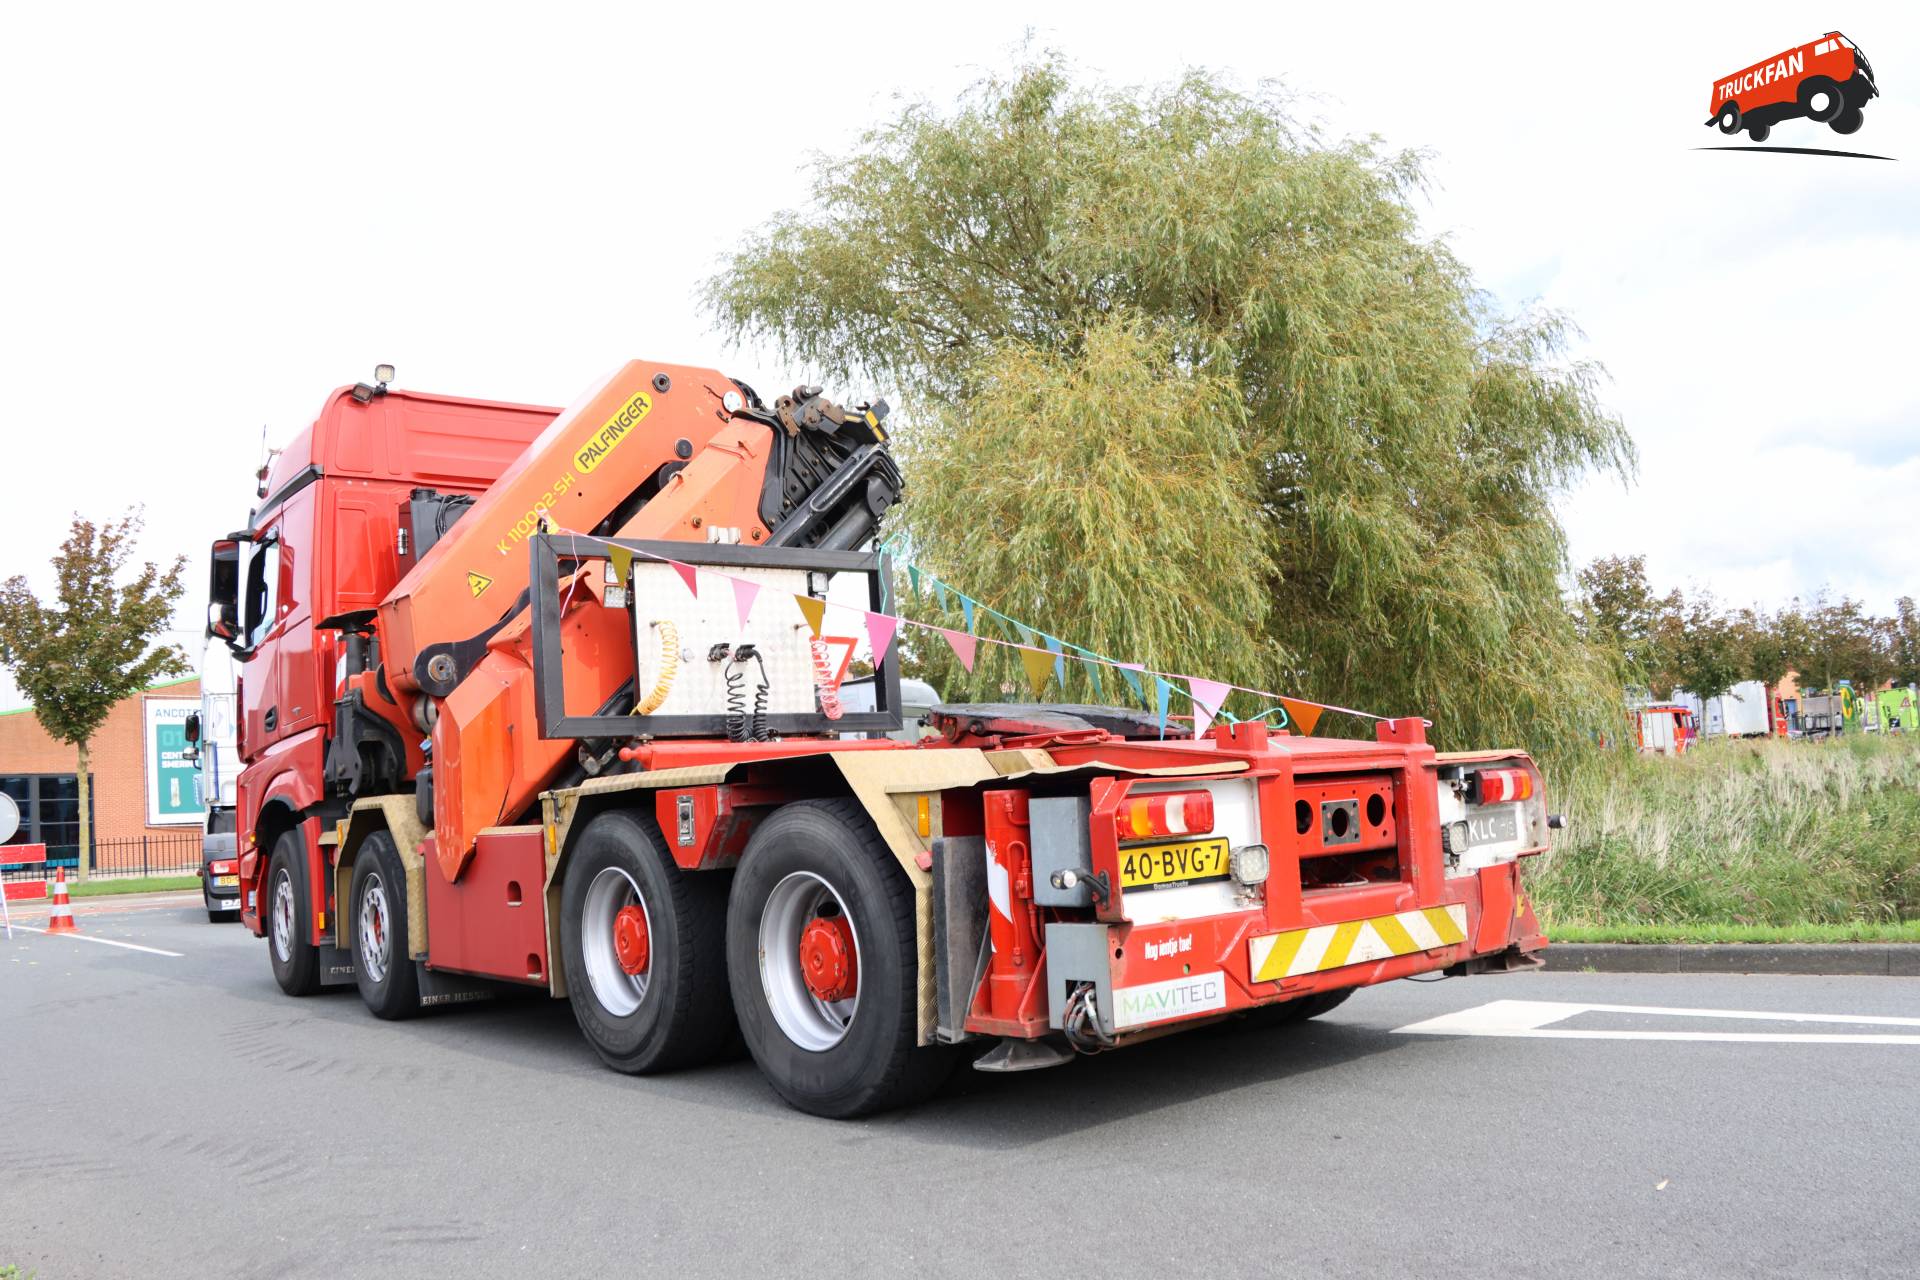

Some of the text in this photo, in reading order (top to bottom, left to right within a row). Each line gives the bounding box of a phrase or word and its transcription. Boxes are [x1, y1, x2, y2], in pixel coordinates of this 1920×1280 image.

[578, 397, 649, 469] PALFINGER
[496, 539, 512, 556] K
[1124, 845, 1221, 880] 40-BVG-7
[222, 899, 241, 907] DA
[1123, 982, 1217, 1015] MAVITEC
